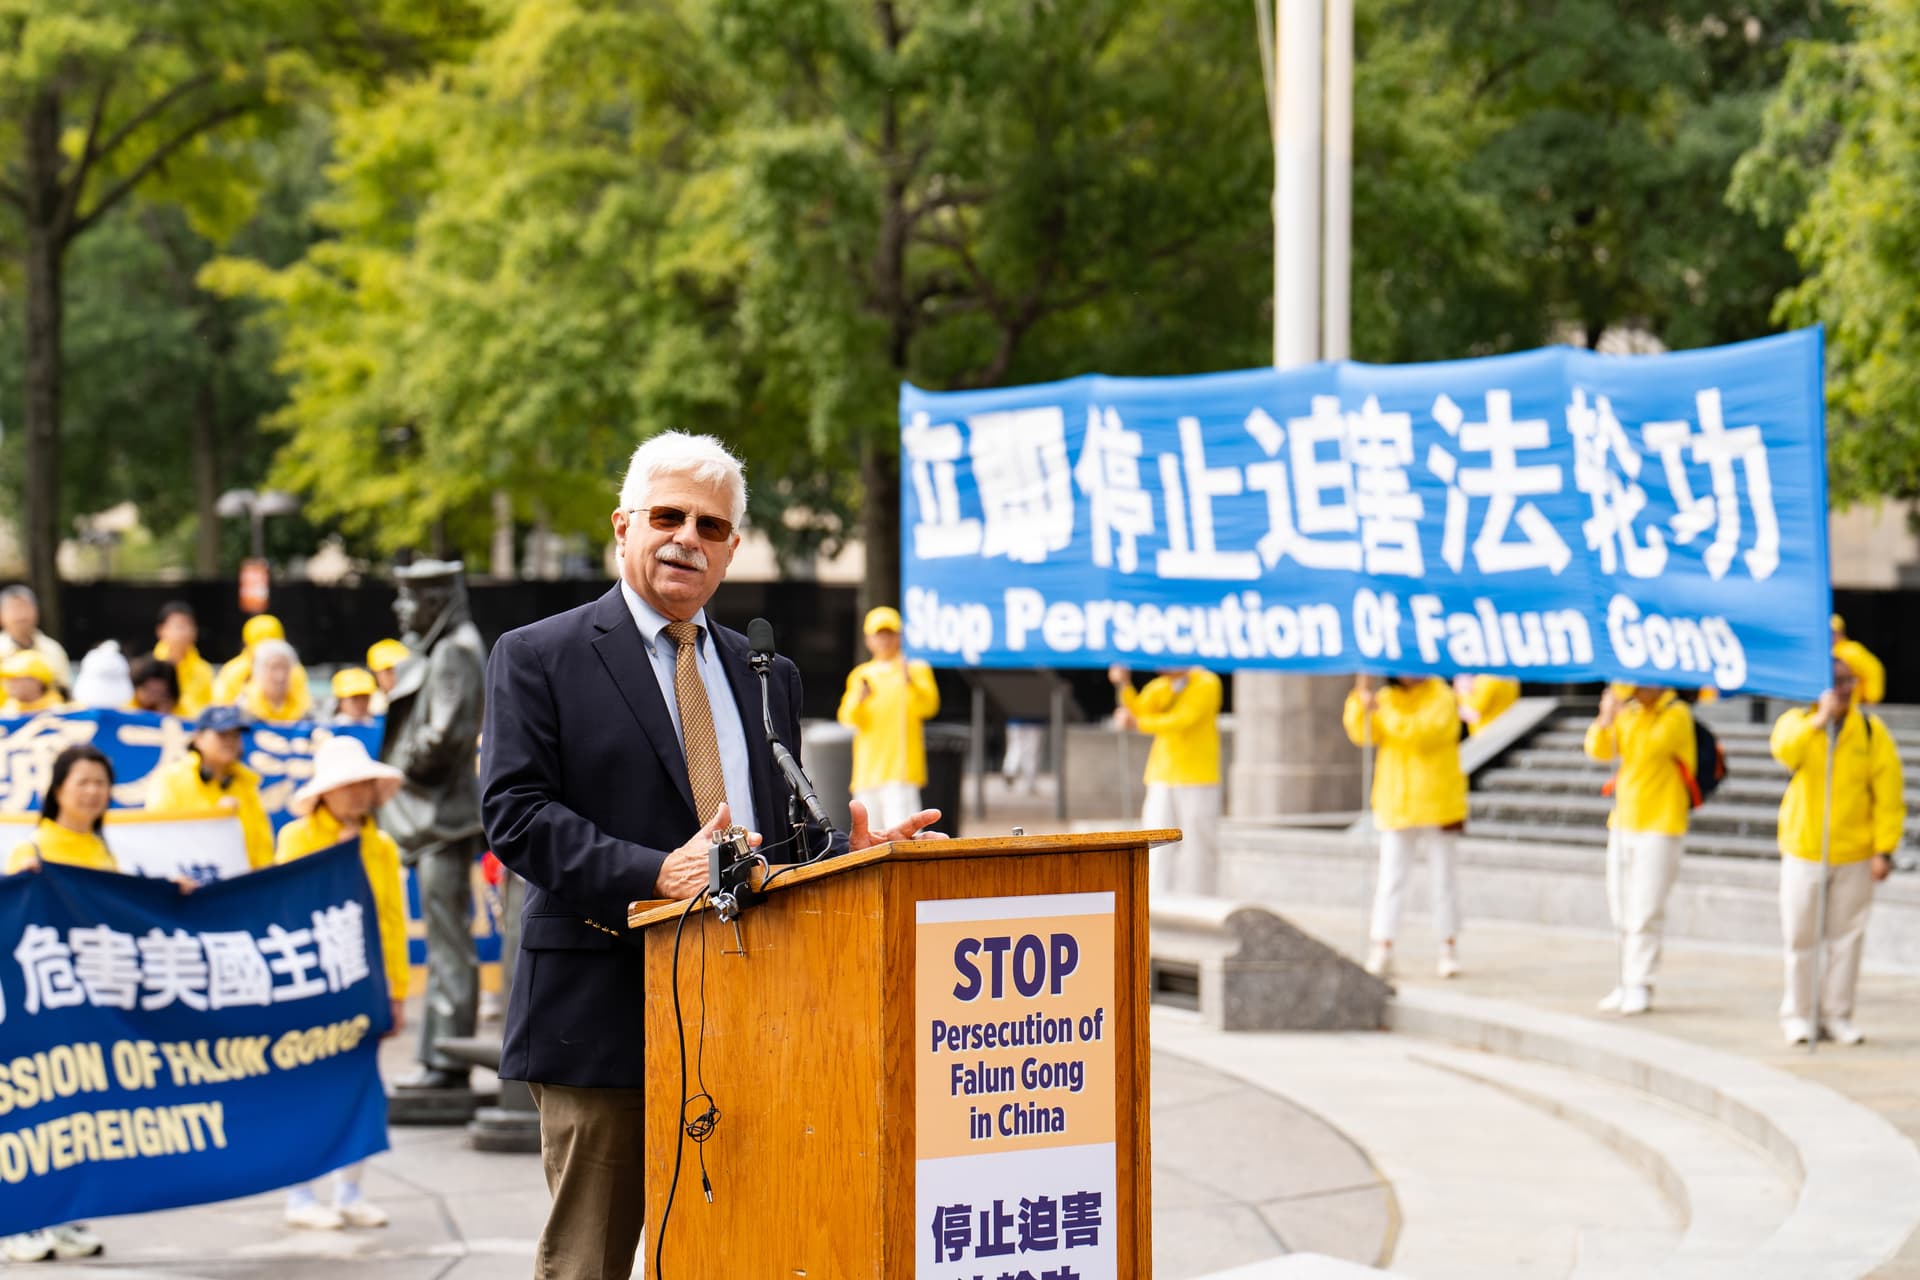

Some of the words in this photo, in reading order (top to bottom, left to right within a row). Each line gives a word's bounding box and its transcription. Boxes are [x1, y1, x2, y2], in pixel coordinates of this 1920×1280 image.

[905, 586, 993, 665] Stop
[1004, 587, 1343, 659] Persecution
[1352, 588, 1402, 660] Of
[1410, 595, 1594, 667] Falun
[1606, 594, 1747, 690] Gong
[13, 900, 370, 1015] 危害美國主權
[953, 933, 1079, 1001] STOP
[931, 1011, 1073, 1052] Persecution
[1078, 1008, 1103, 1042] of
[112, 1040, 163, 1091] OF
[951, 1060, 1015, 1096] Falun
[1021, 1057, 1084, 1092] Gong
[970, 1106, 991, 1139] in
[998, 1101, 1065, 1136] China
[931, 1190, 1102, 1264] 停止迫害
